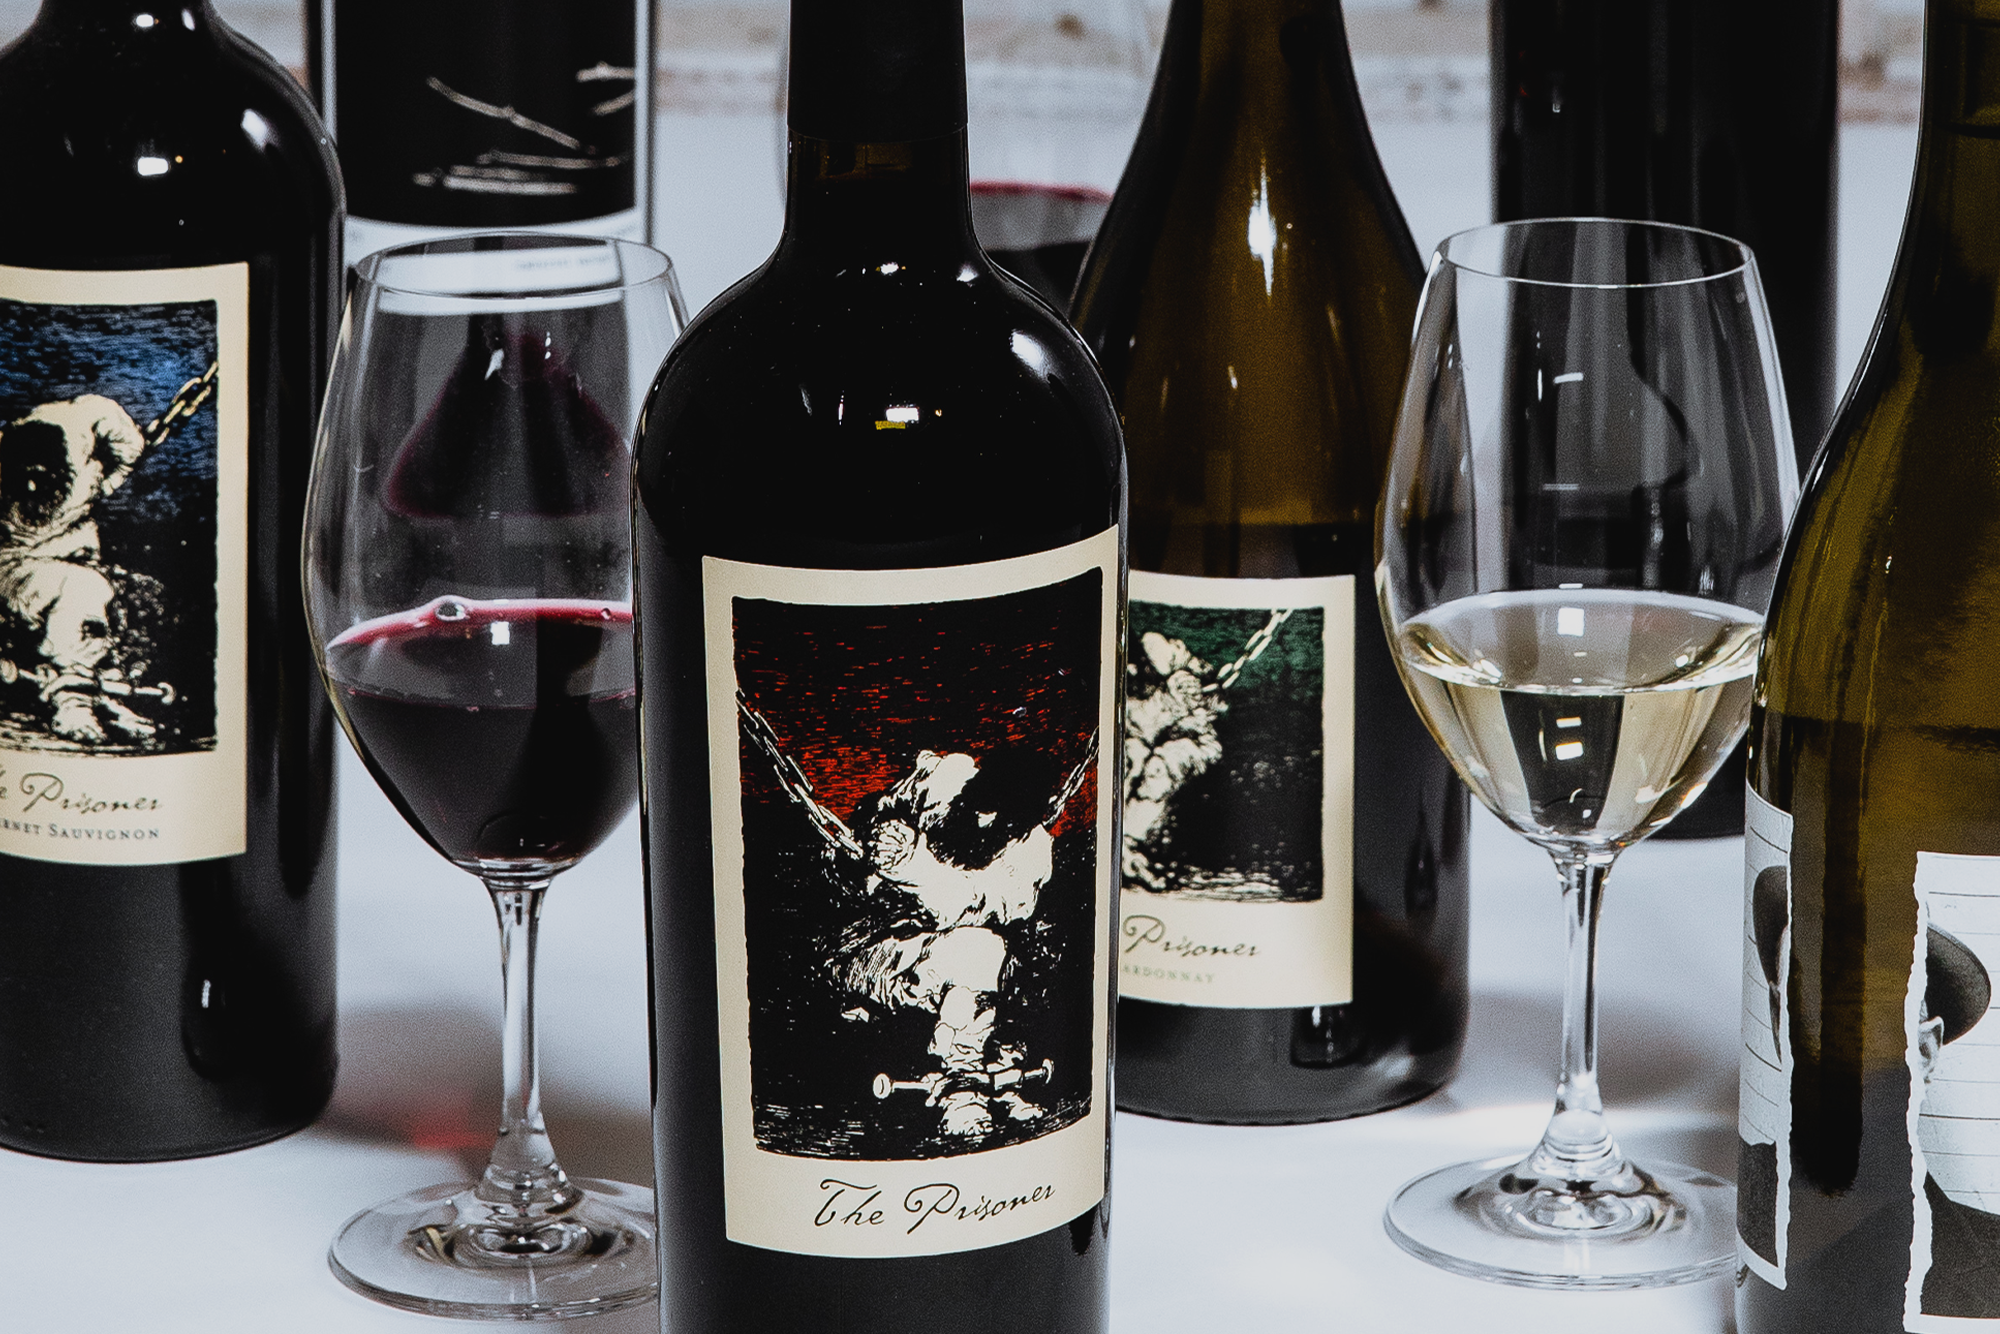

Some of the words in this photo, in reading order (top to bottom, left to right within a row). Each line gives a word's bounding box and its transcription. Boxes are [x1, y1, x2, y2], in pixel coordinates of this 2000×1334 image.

[20, 772, 161, 814] Prisoner
[1123, 914, 1261, 957] Prisoner
[814, 1178, 885, 1227] The
[903, 1183, 1056, 1235] Prisoner
